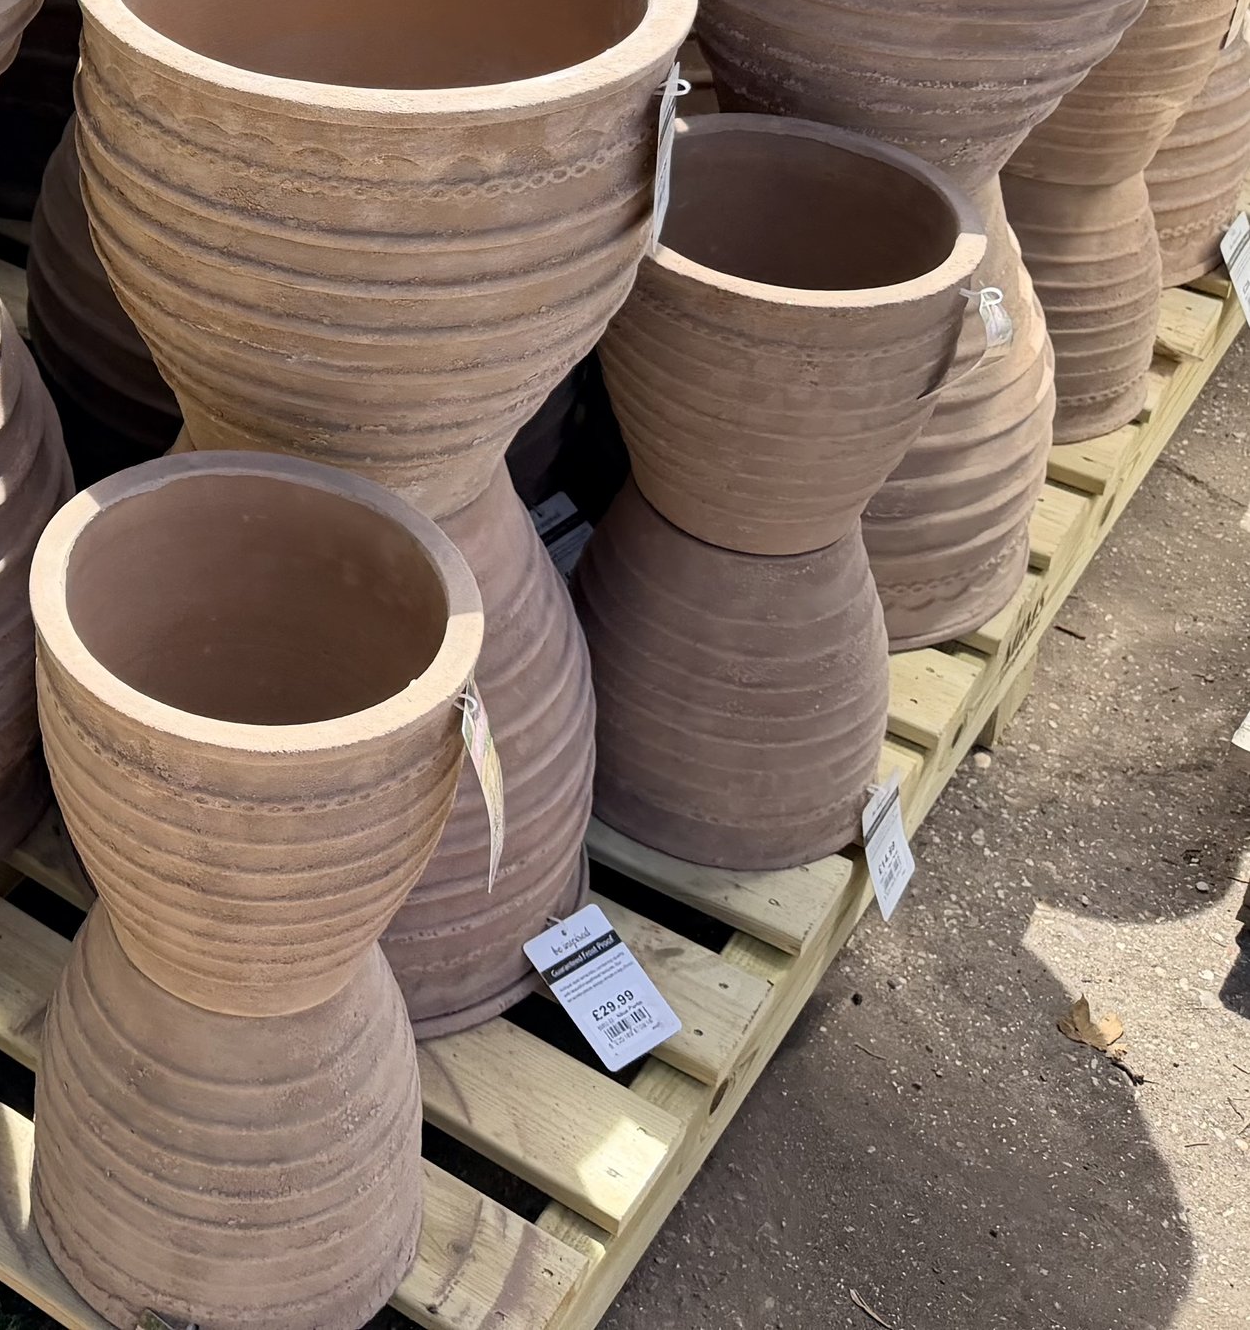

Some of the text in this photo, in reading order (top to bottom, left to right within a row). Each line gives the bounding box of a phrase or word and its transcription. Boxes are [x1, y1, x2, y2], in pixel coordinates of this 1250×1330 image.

[551, 943, 563, 956] be
[551, 954, 584, 978] Guaranteed
[596, 934, 614, 951] Proof
[591, 989, 635, 1022] £29.99
